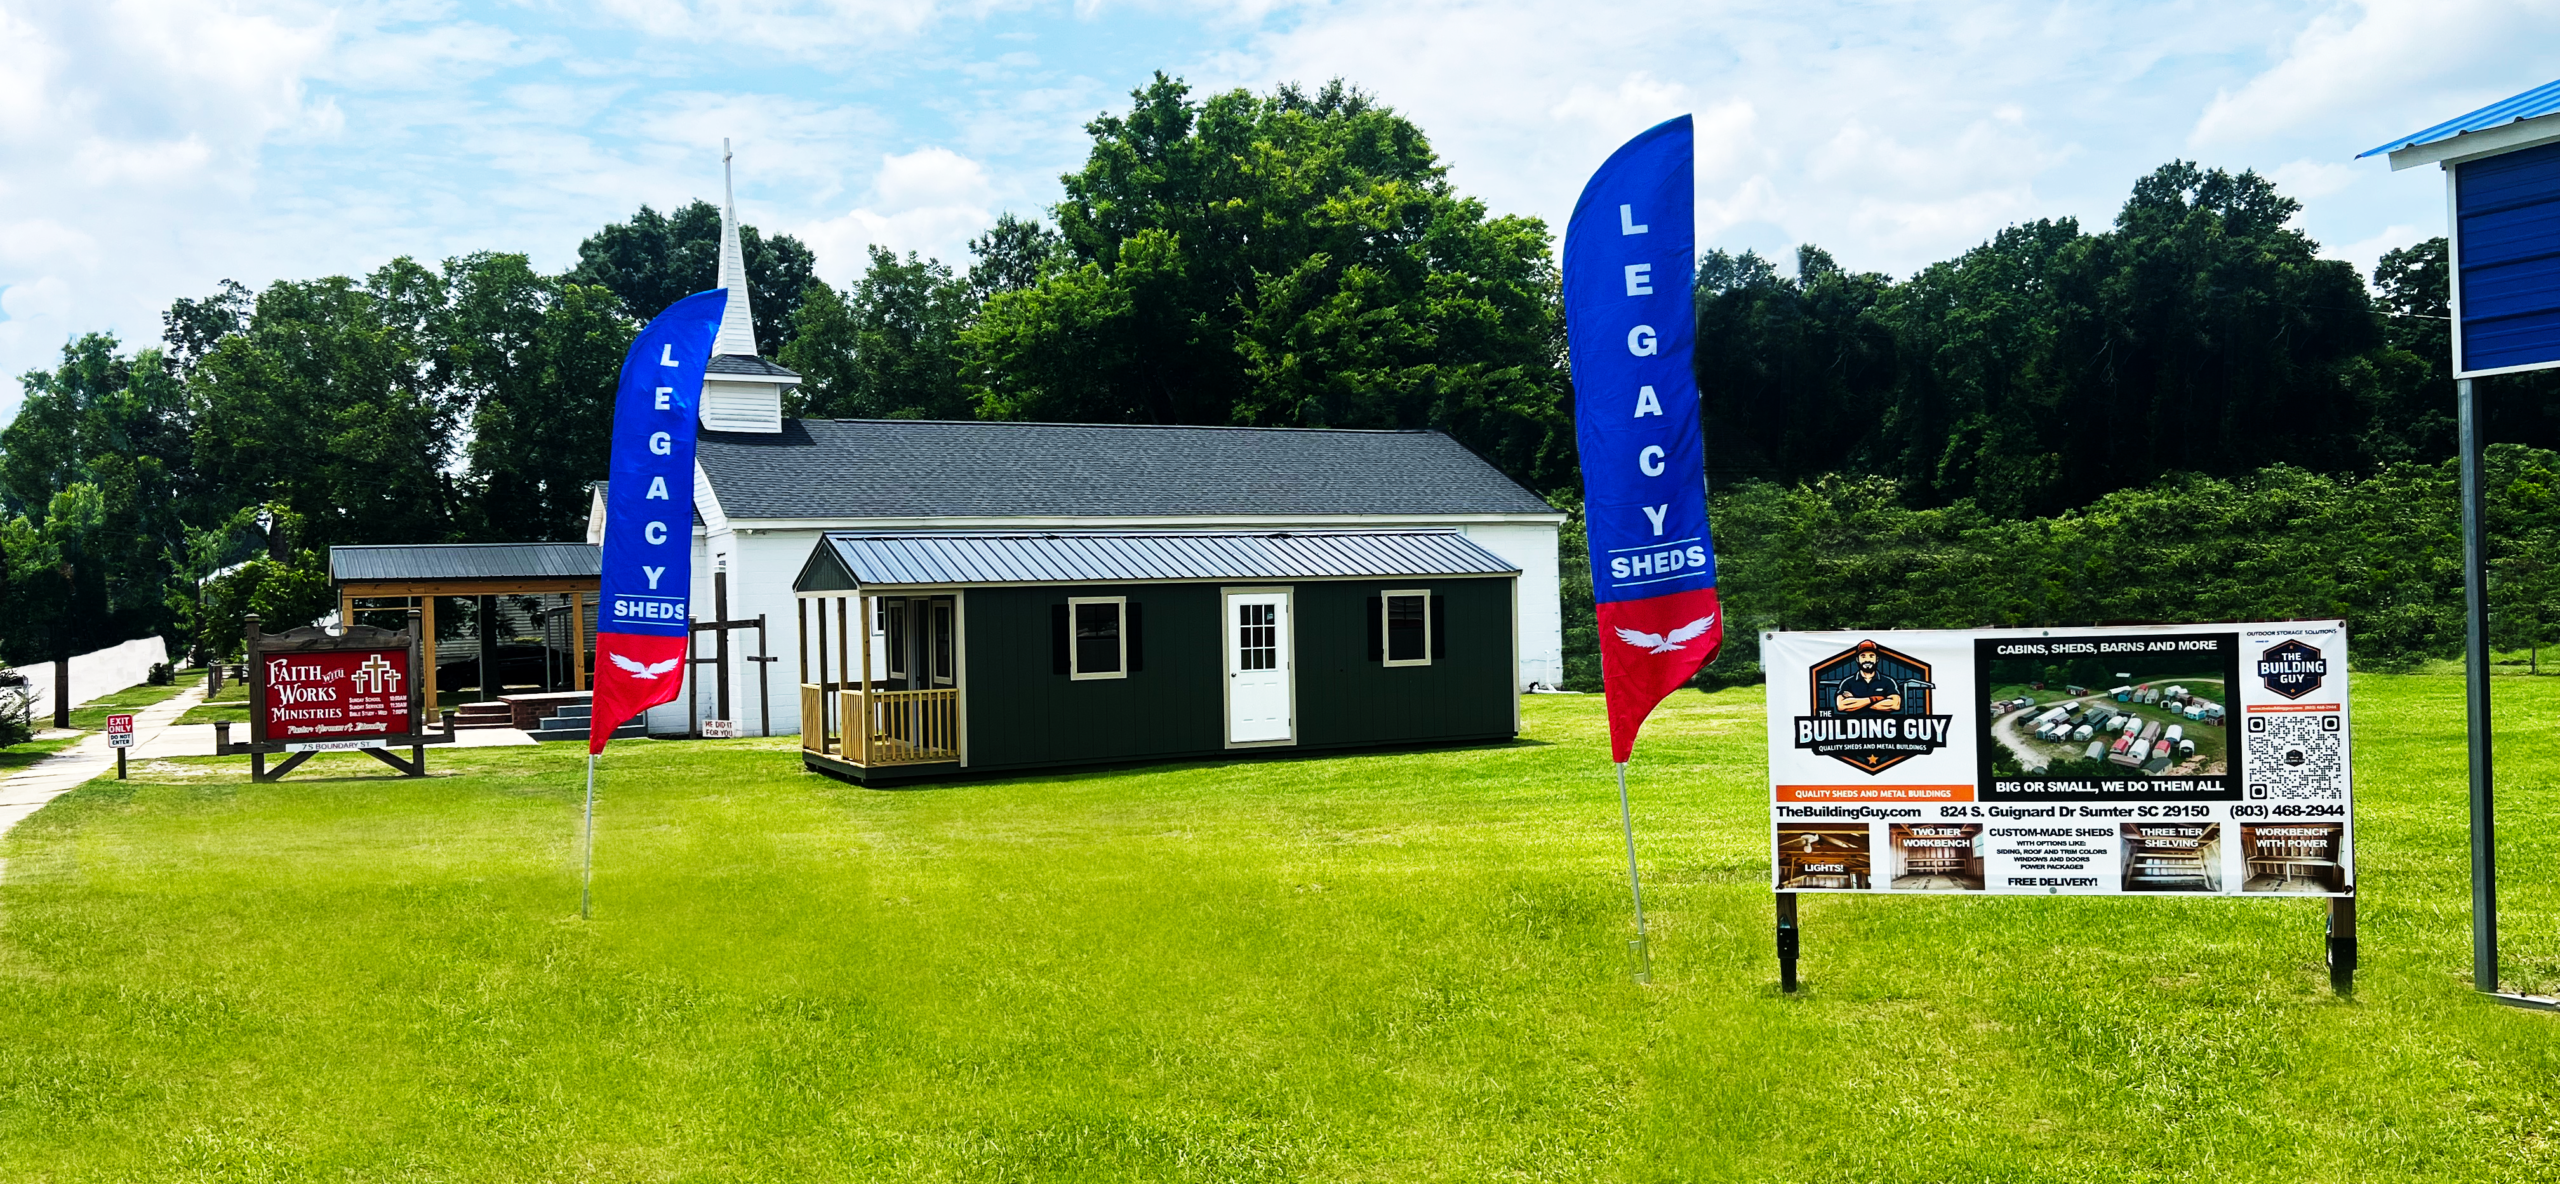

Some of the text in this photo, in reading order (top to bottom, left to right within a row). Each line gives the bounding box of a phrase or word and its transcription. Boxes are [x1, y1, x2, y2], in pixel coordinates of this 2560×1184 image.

[1620, 204, 1668, 536] LEGACY
[641, 343, 679, 590] LEGACY
[1611, 545, 1706, 579] SHEDS
[614, 600, 684, 620] SHEDS
[1997, 640, 2218, 655] CABINS, SHEDS, BARNS AND MORE
[2282, 653, 2302, 661] THE
[2260, 661, 2324, 675] BUILDING
[266, 659, 321, 687] FAITH
[2280, 674, 2304, 683] GUY
[274, 683, 337, 707] WORKS
[271, 707, 342, 723] MINISTRIES
[1819, 710, 1832, 718] THE
[109, 717, 130, 725] EXIT
[109, 725, 131, 733] ONLY
[720, 729, 733, 737] YOU
[1799, 719, 1947, 743] BUILDING GUY
[315, 742, 358, 750] BOUNDARY
[1819, 744, 1843, 752] QUALITY
[1995, 781, 2225, 794] BIG OR SMALL, WE DO THEM ALL
[1795, 790, 1951, 798] QUALITY SHEDS AND METAL BUILDINGS
[1776, 804, 2345, 820] TheBuildingGuy.com 824 S. Guignard Dr Sumter SC 29150 (803) 468-2944
[1911, 828, 1960, 836] TWO TIER
[1989, 828, 2114, 837] CUSTOM-MADE SHEDS
[2139, 828, 2203, 836] THREE TIER
[2255, 828, 2328, 836] WORKBENCH
[1903, 839, 1970, 847] WORKBENCH
[2145, 839, 2198, 848] SHELVING
[2256, 839, 2327, 848] WITH POWER
[1805, 864, 1843, 872] LIGHTS!
[2007, 877, 2098, 886] FREE DELIVERY!
